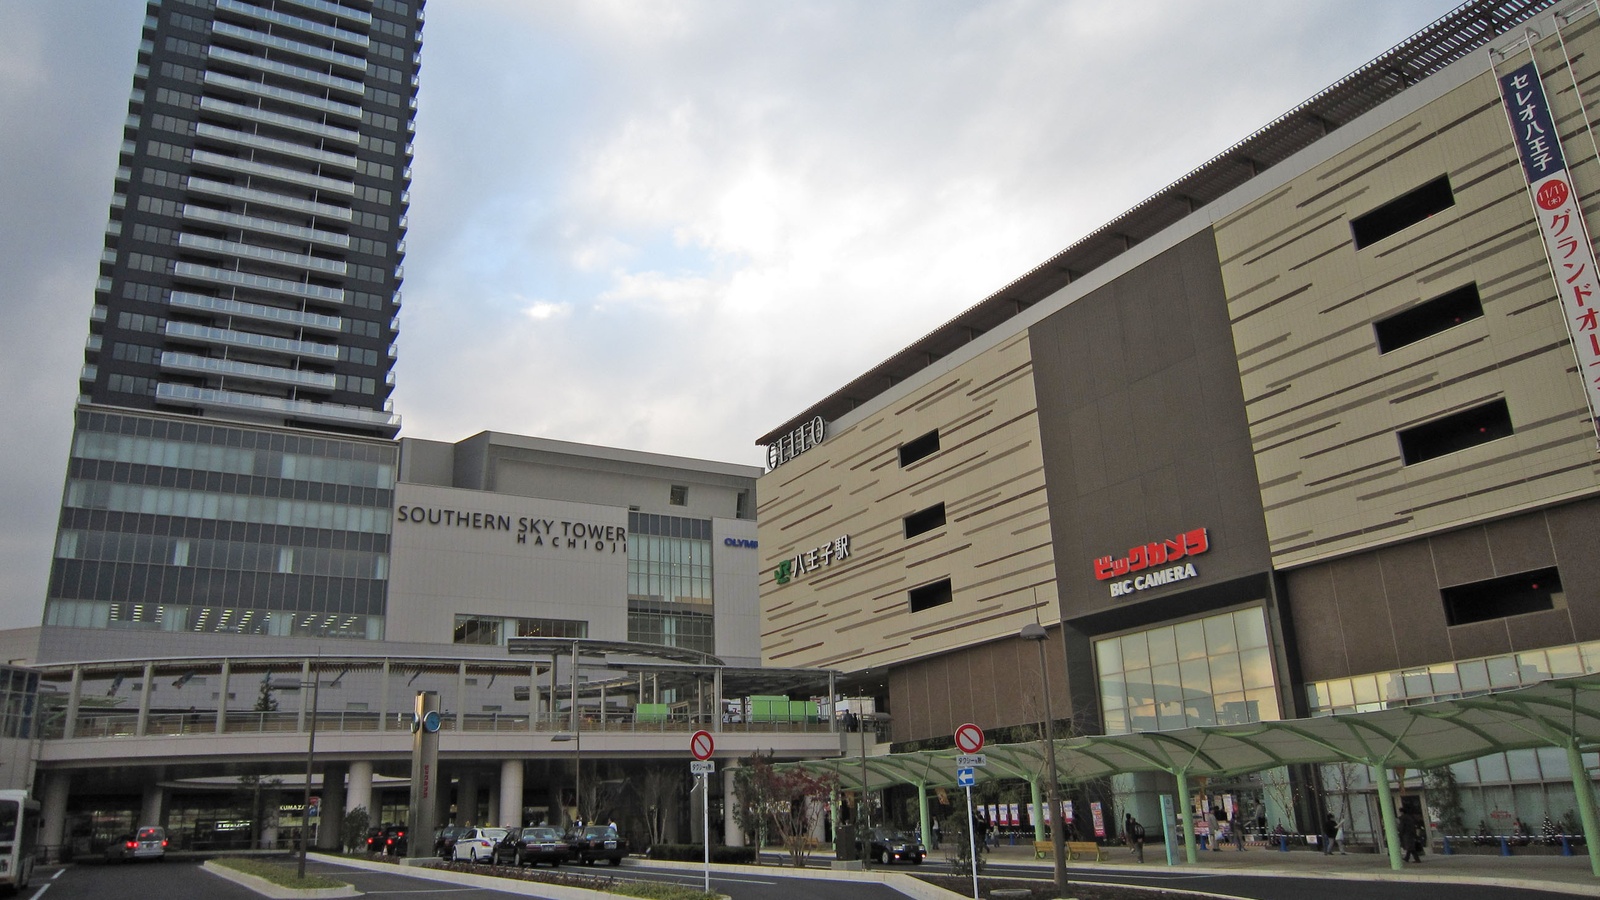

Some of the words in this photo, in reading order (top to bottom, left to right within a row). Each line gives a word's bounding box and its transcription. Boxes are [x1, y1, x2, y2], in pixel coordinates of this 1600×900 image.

[1510, 73, 1553, 172] セレオ八王子
[1538, 182, 1565, 202] 11/11
[766, 415, 825, 471] CELEO
[398, 505, 511, 531] SOUTHERN
[518, 517, 555, 535] SKY
[561, 521, 627, 542] TOWER
[517, 533, 627, 553] HACHIOJI
[774, 559, 791, 585] JR
[794, 534, 849, 578] 八王子駅
[1094, 527, 1209, 580] ビックカメラ
[1110, 579, 1135, 598] BIC
[1135, 563, 1198, 591] CAMERA
